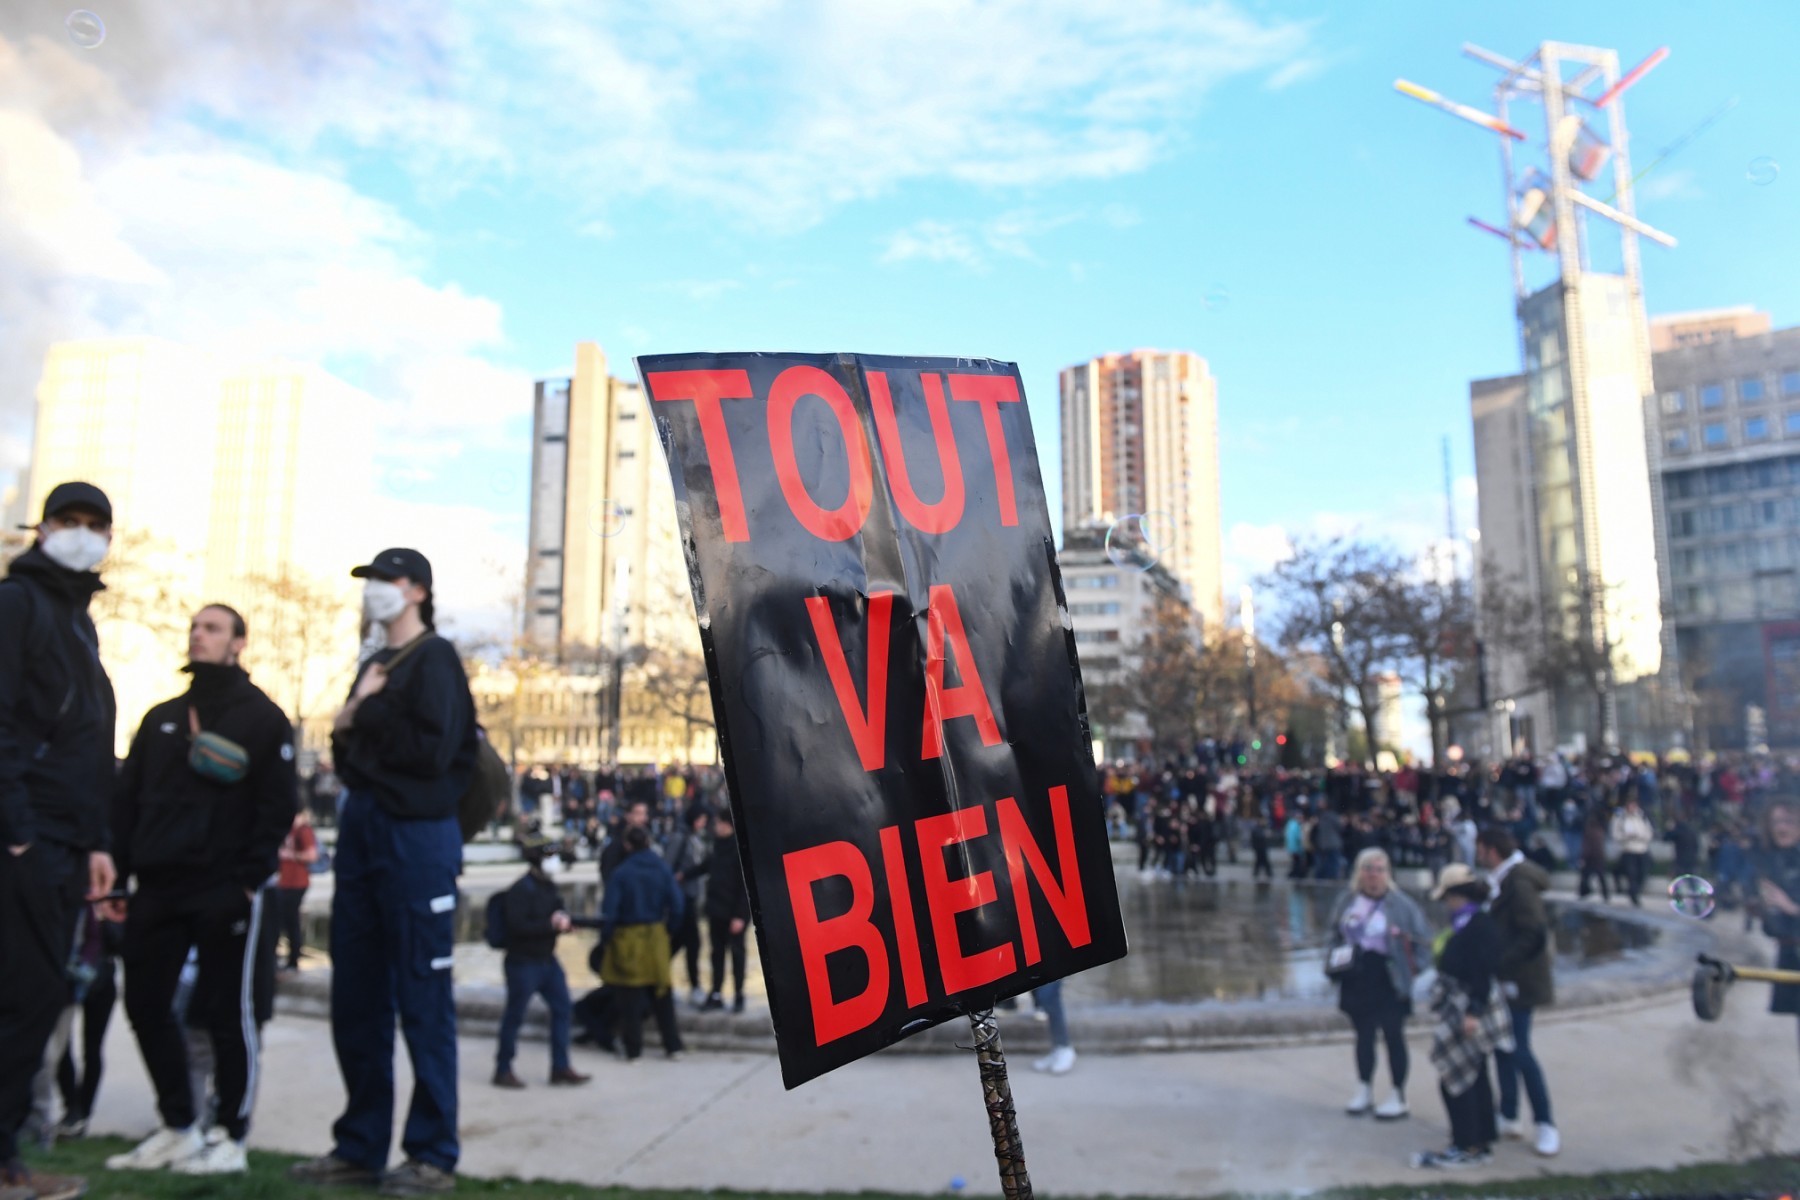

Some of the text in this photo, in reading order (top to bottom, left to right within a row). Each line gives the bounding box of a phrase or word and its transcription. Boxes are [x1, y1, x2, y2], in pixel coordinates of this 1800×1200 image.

[647, 365, 1020, 543] TOUT
[804, 584, 1003, 772] VA
[783, 785, 1091, 1046] BIEN
